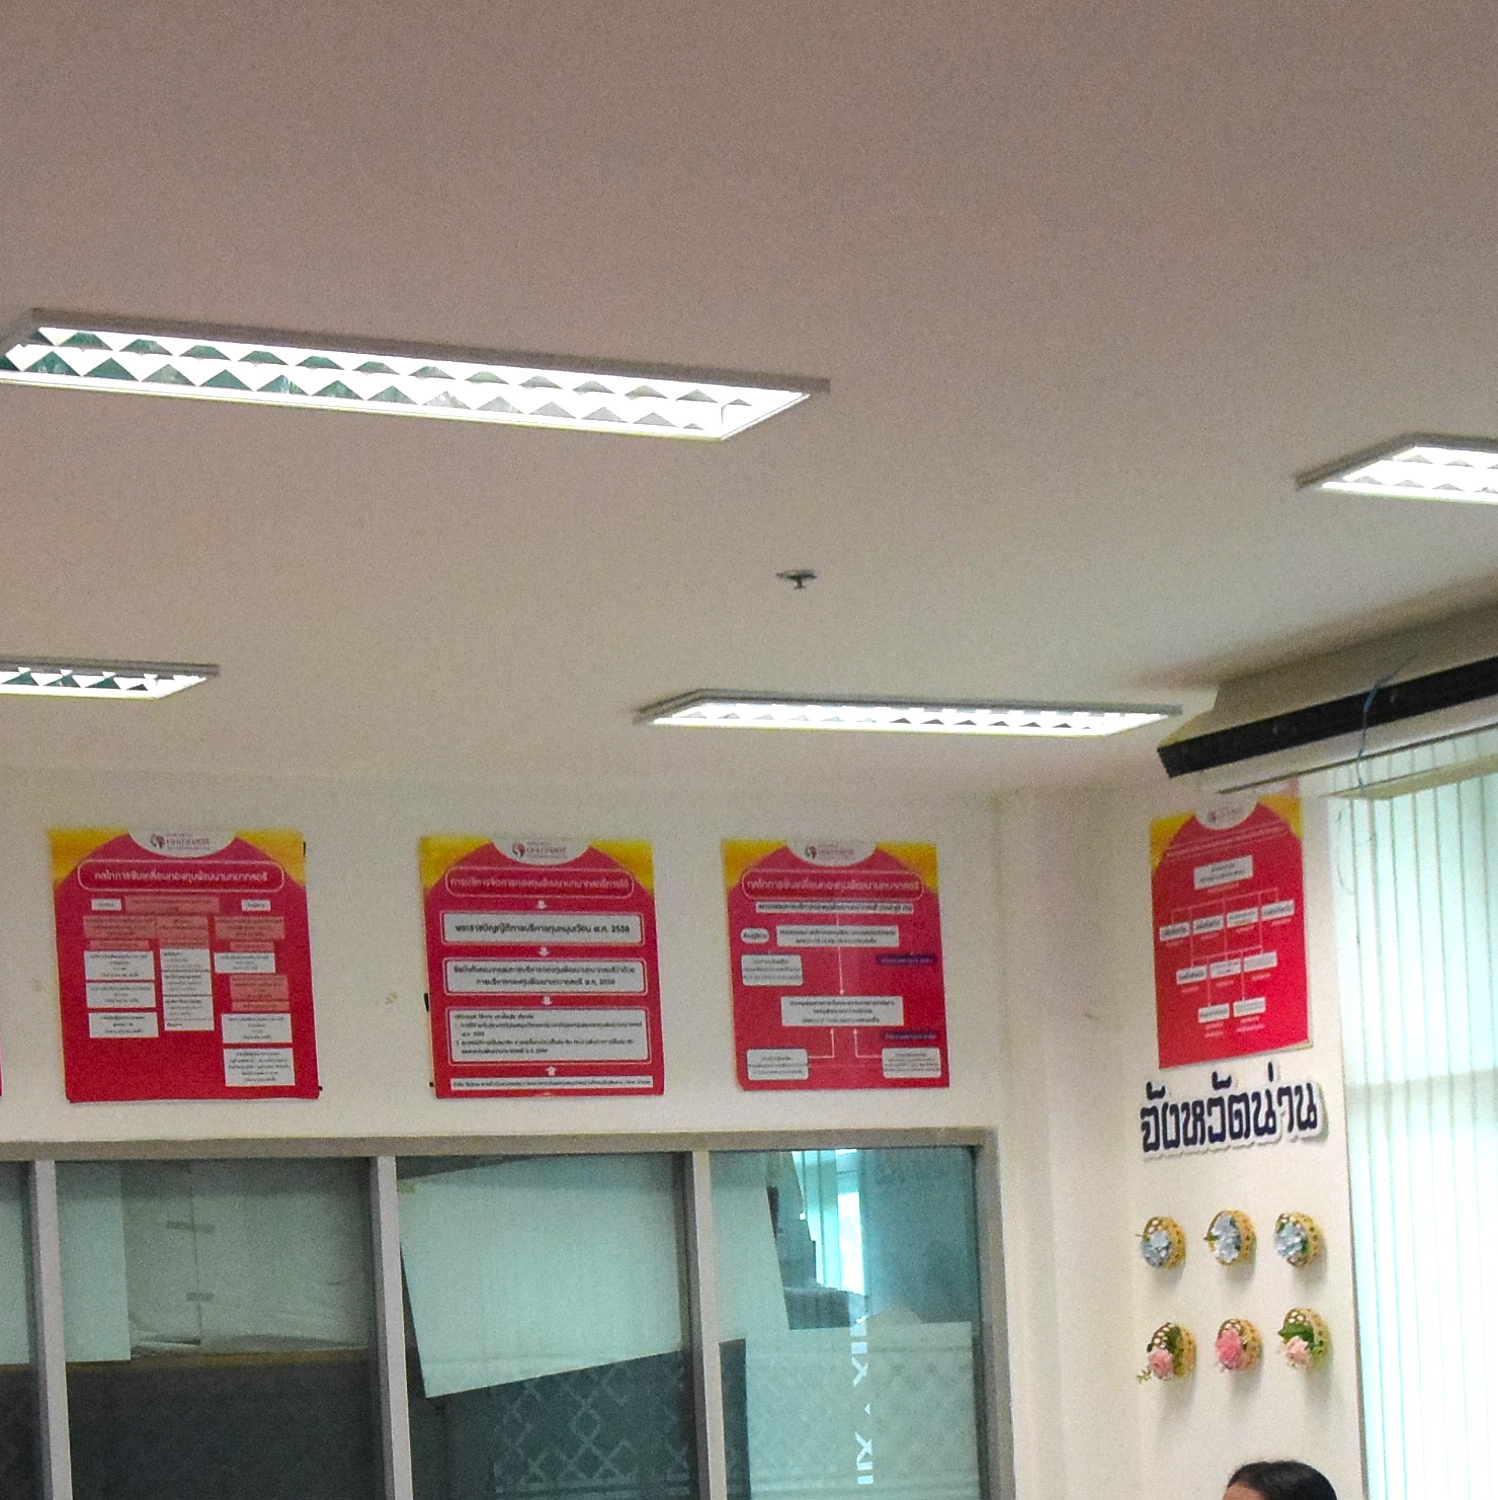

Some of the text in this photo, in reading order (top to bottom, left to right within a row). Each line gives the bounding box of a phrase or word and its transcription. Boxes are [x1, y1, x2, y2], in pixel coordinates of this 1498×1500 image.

[1140, 1061, 1319, 1154] จังหวัดน่าน
